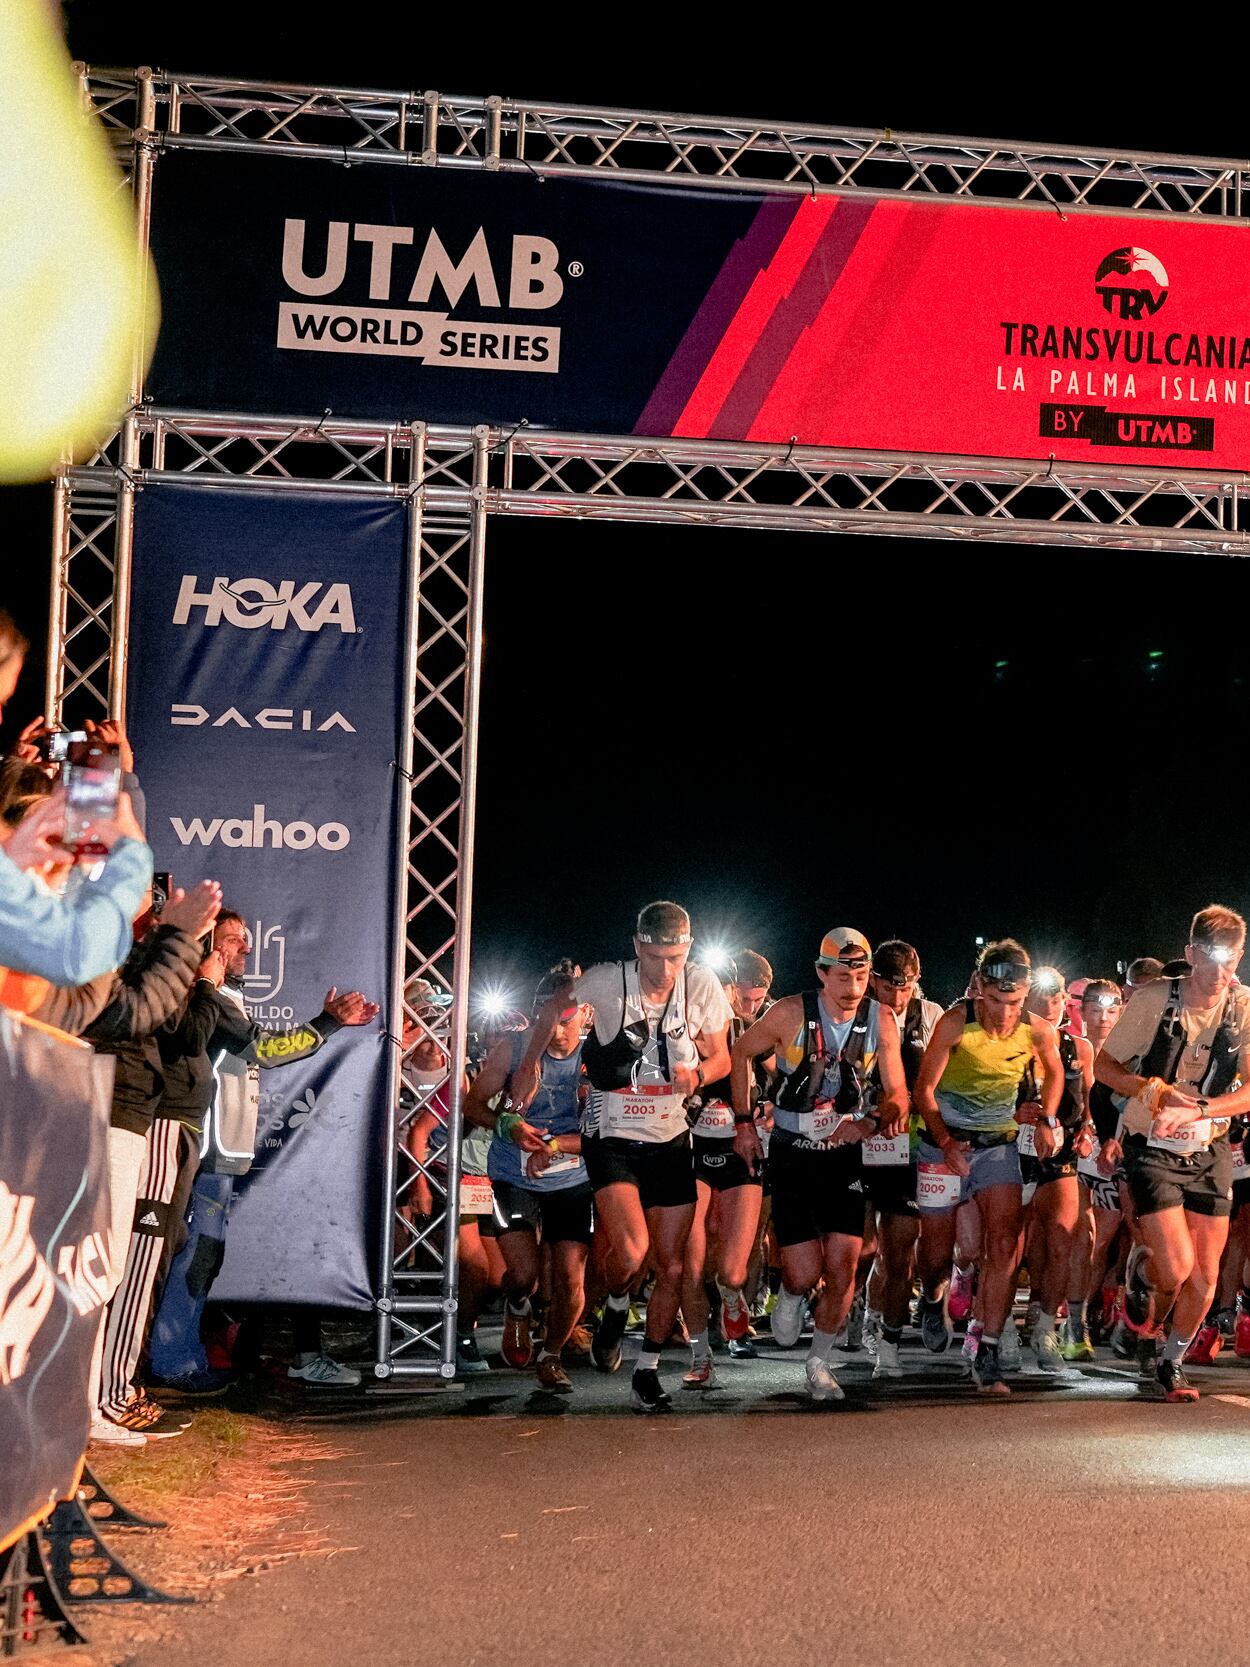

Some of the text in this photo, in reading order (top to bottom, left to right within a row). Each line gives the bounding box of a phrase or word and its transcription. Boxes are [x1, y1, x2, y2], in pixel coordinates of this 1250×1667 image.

[1095, 286, 1168, 320] TRV
[291, 313, 549, 363] WORLD SERIES
[996, 366, 1026, 391] LA
[1050, 369, 1137, 398] PALMA
[1054, 410, 1193, 445] BY UTMB
[172, 575, 357, 633] HOKA
[171, 704, 357, 733] DACIA
[169, 804, 350, 851] wahoo
[244, 1006, 294, 1020] BILDO
[623, 1105, 655, 1115] 2003
[698, 1115, 727, 1126] 2004
[265, 1138, 283, 1148] VIDA
[867, 1142, 895, 1152] 2033
[919, 1182, 946, 1194] 2009
